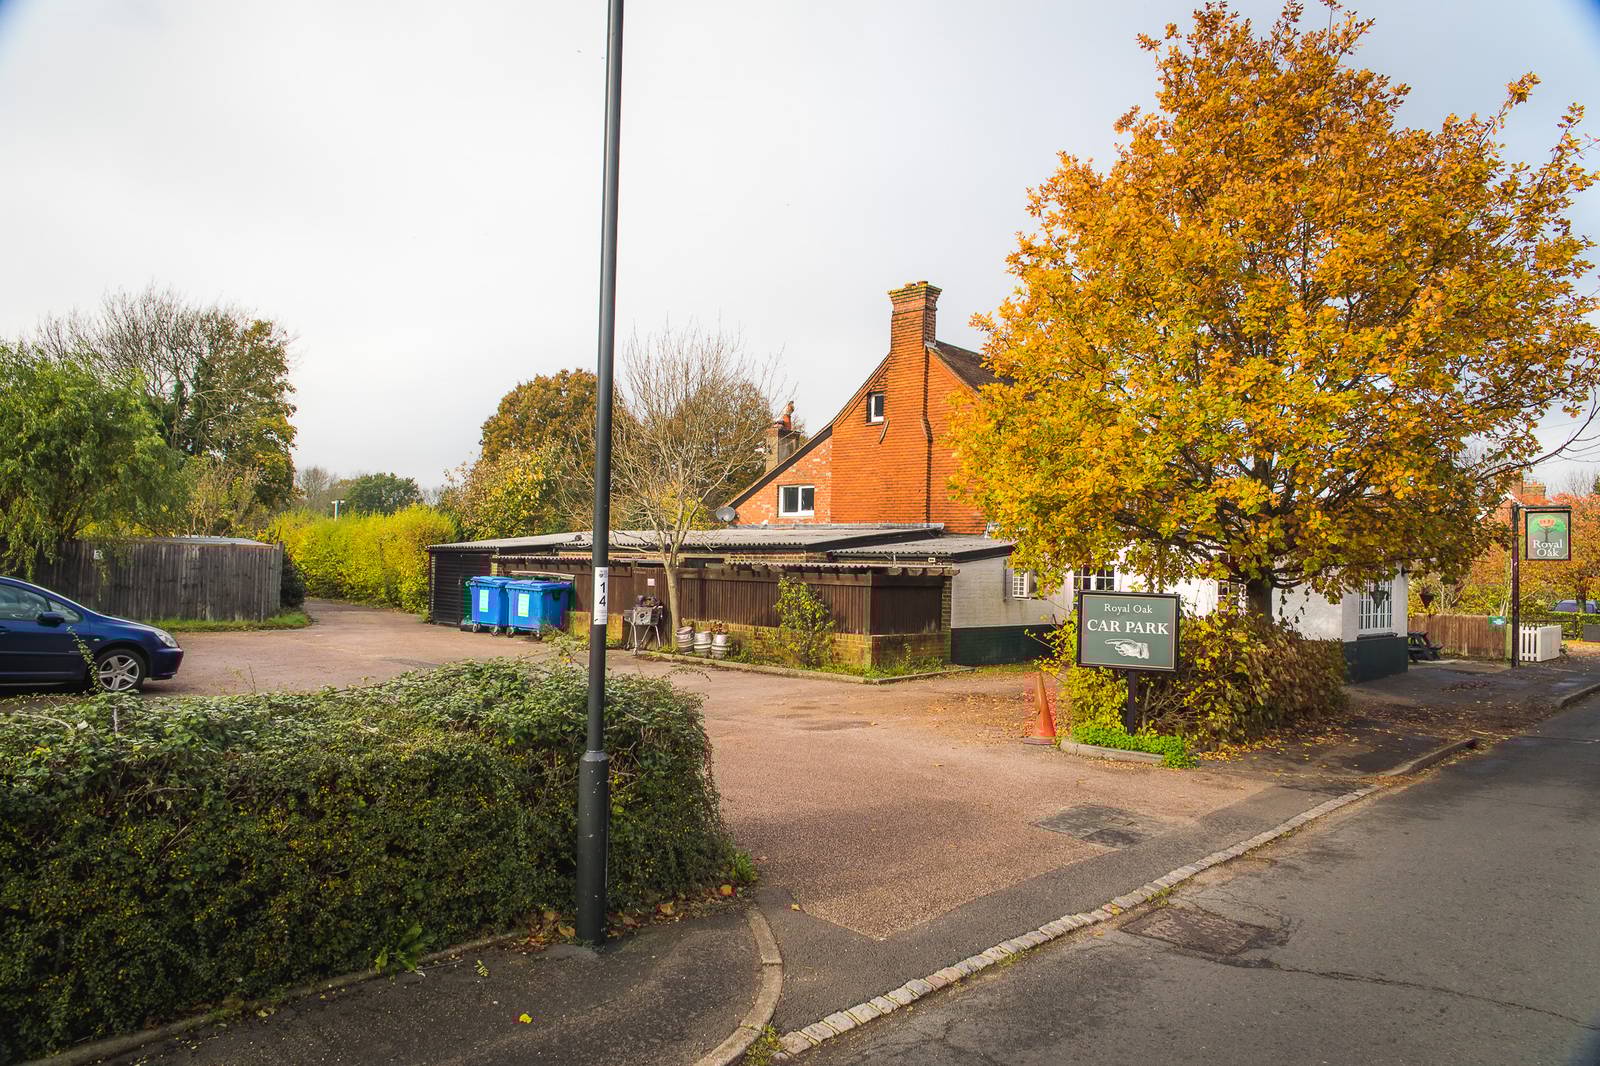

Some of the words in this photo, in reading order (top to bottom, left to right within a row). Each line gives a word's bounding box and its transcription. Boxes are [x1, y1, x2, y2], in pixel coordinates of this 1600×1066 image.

[1533, 539, 1562, 549] Royal
[1536, 549, 1559, 557] Oak
[1104, 603, 1130, 615] Royal
[1133, 604, 1153, 614] Oak
[1087, 619, 1121, 632] CAR
[1125, 621, 1169, 635] PARK
